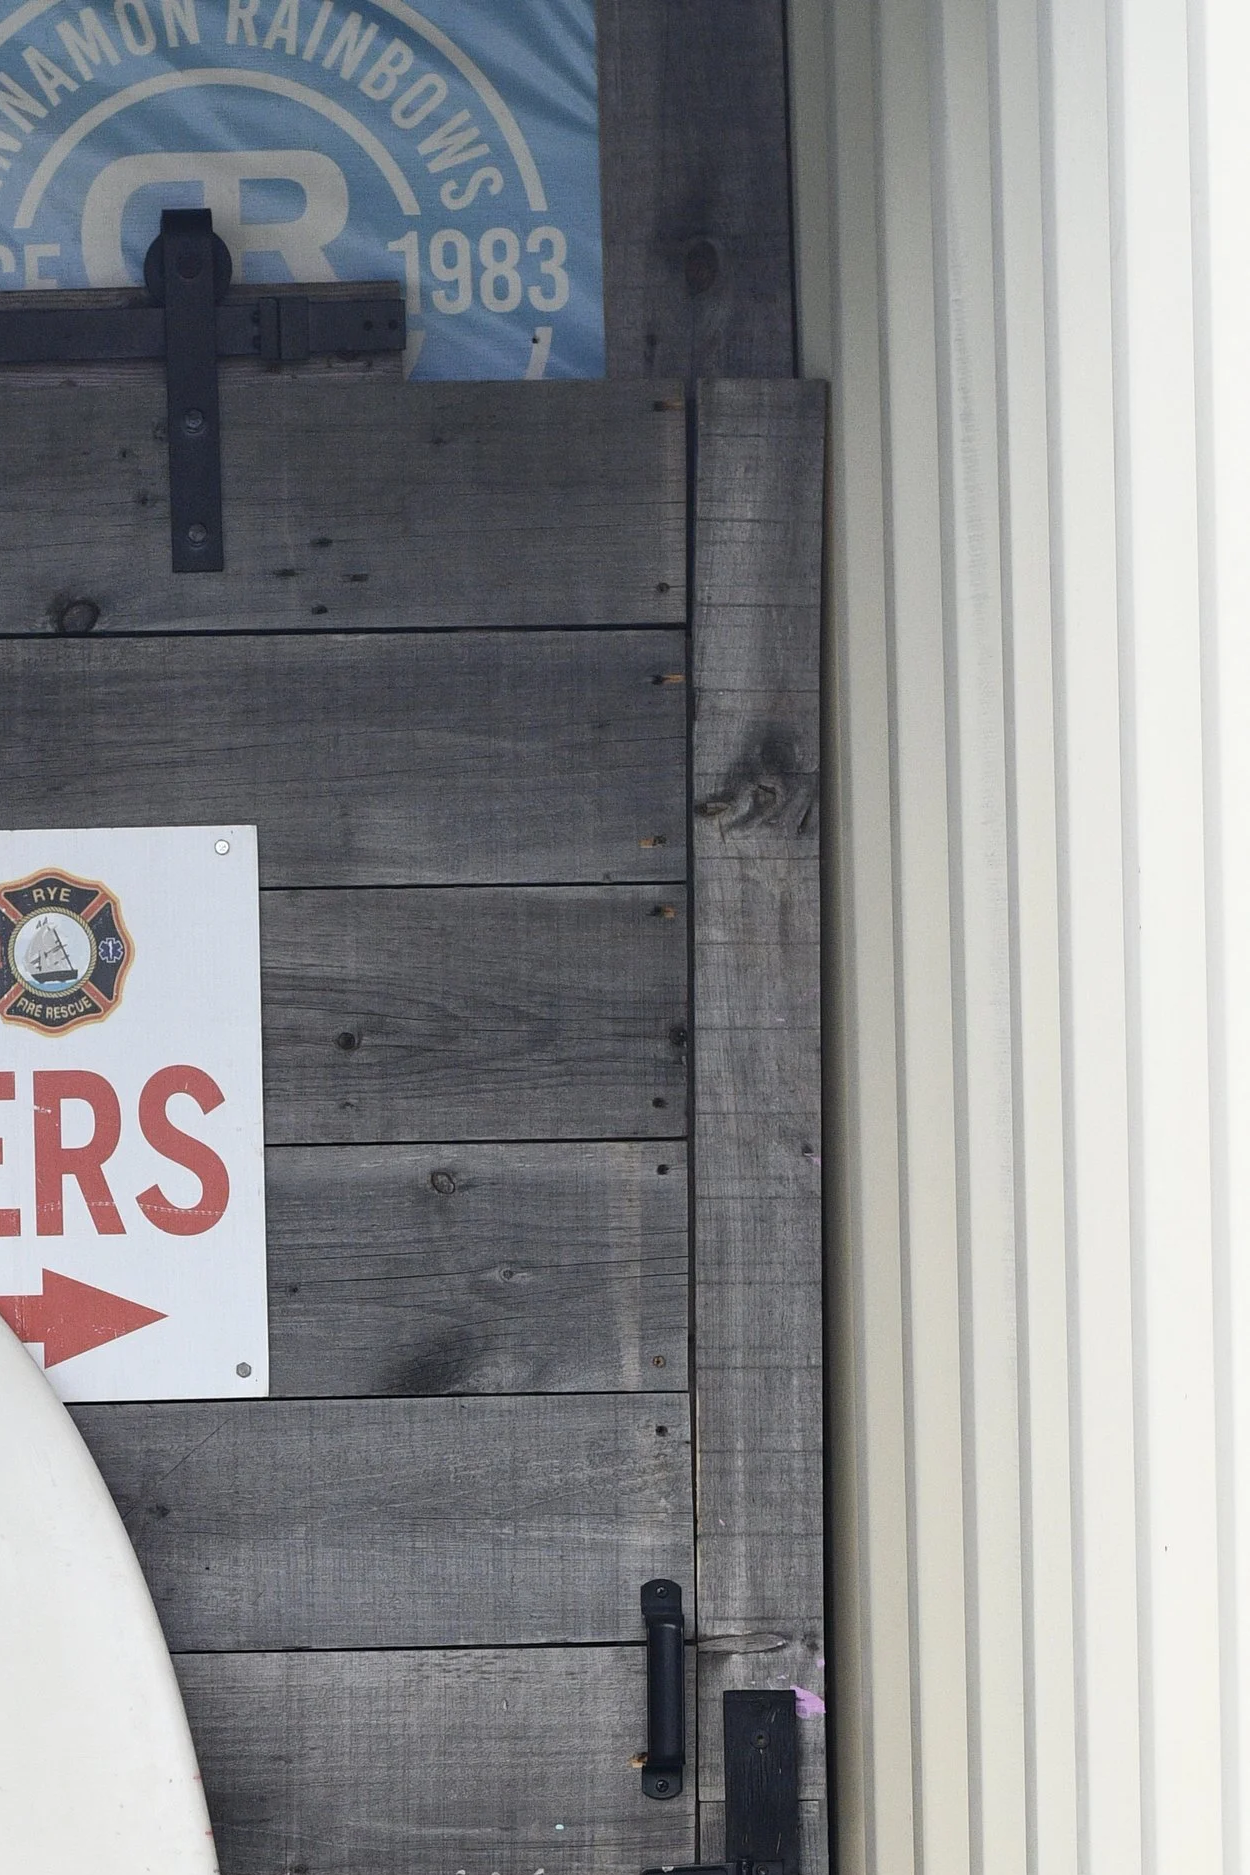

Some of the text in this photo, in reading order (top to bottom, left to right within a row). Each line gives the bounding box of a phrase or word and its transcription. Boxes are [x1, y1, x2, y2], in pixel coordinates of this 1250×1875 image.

[225, 0, 504, 211] RAINBOWS
[387, 226, 570, 316] 1983
[32, 887, 72, 904] RYE
[16, 995, 93, 1020] FIRE RESCUE
